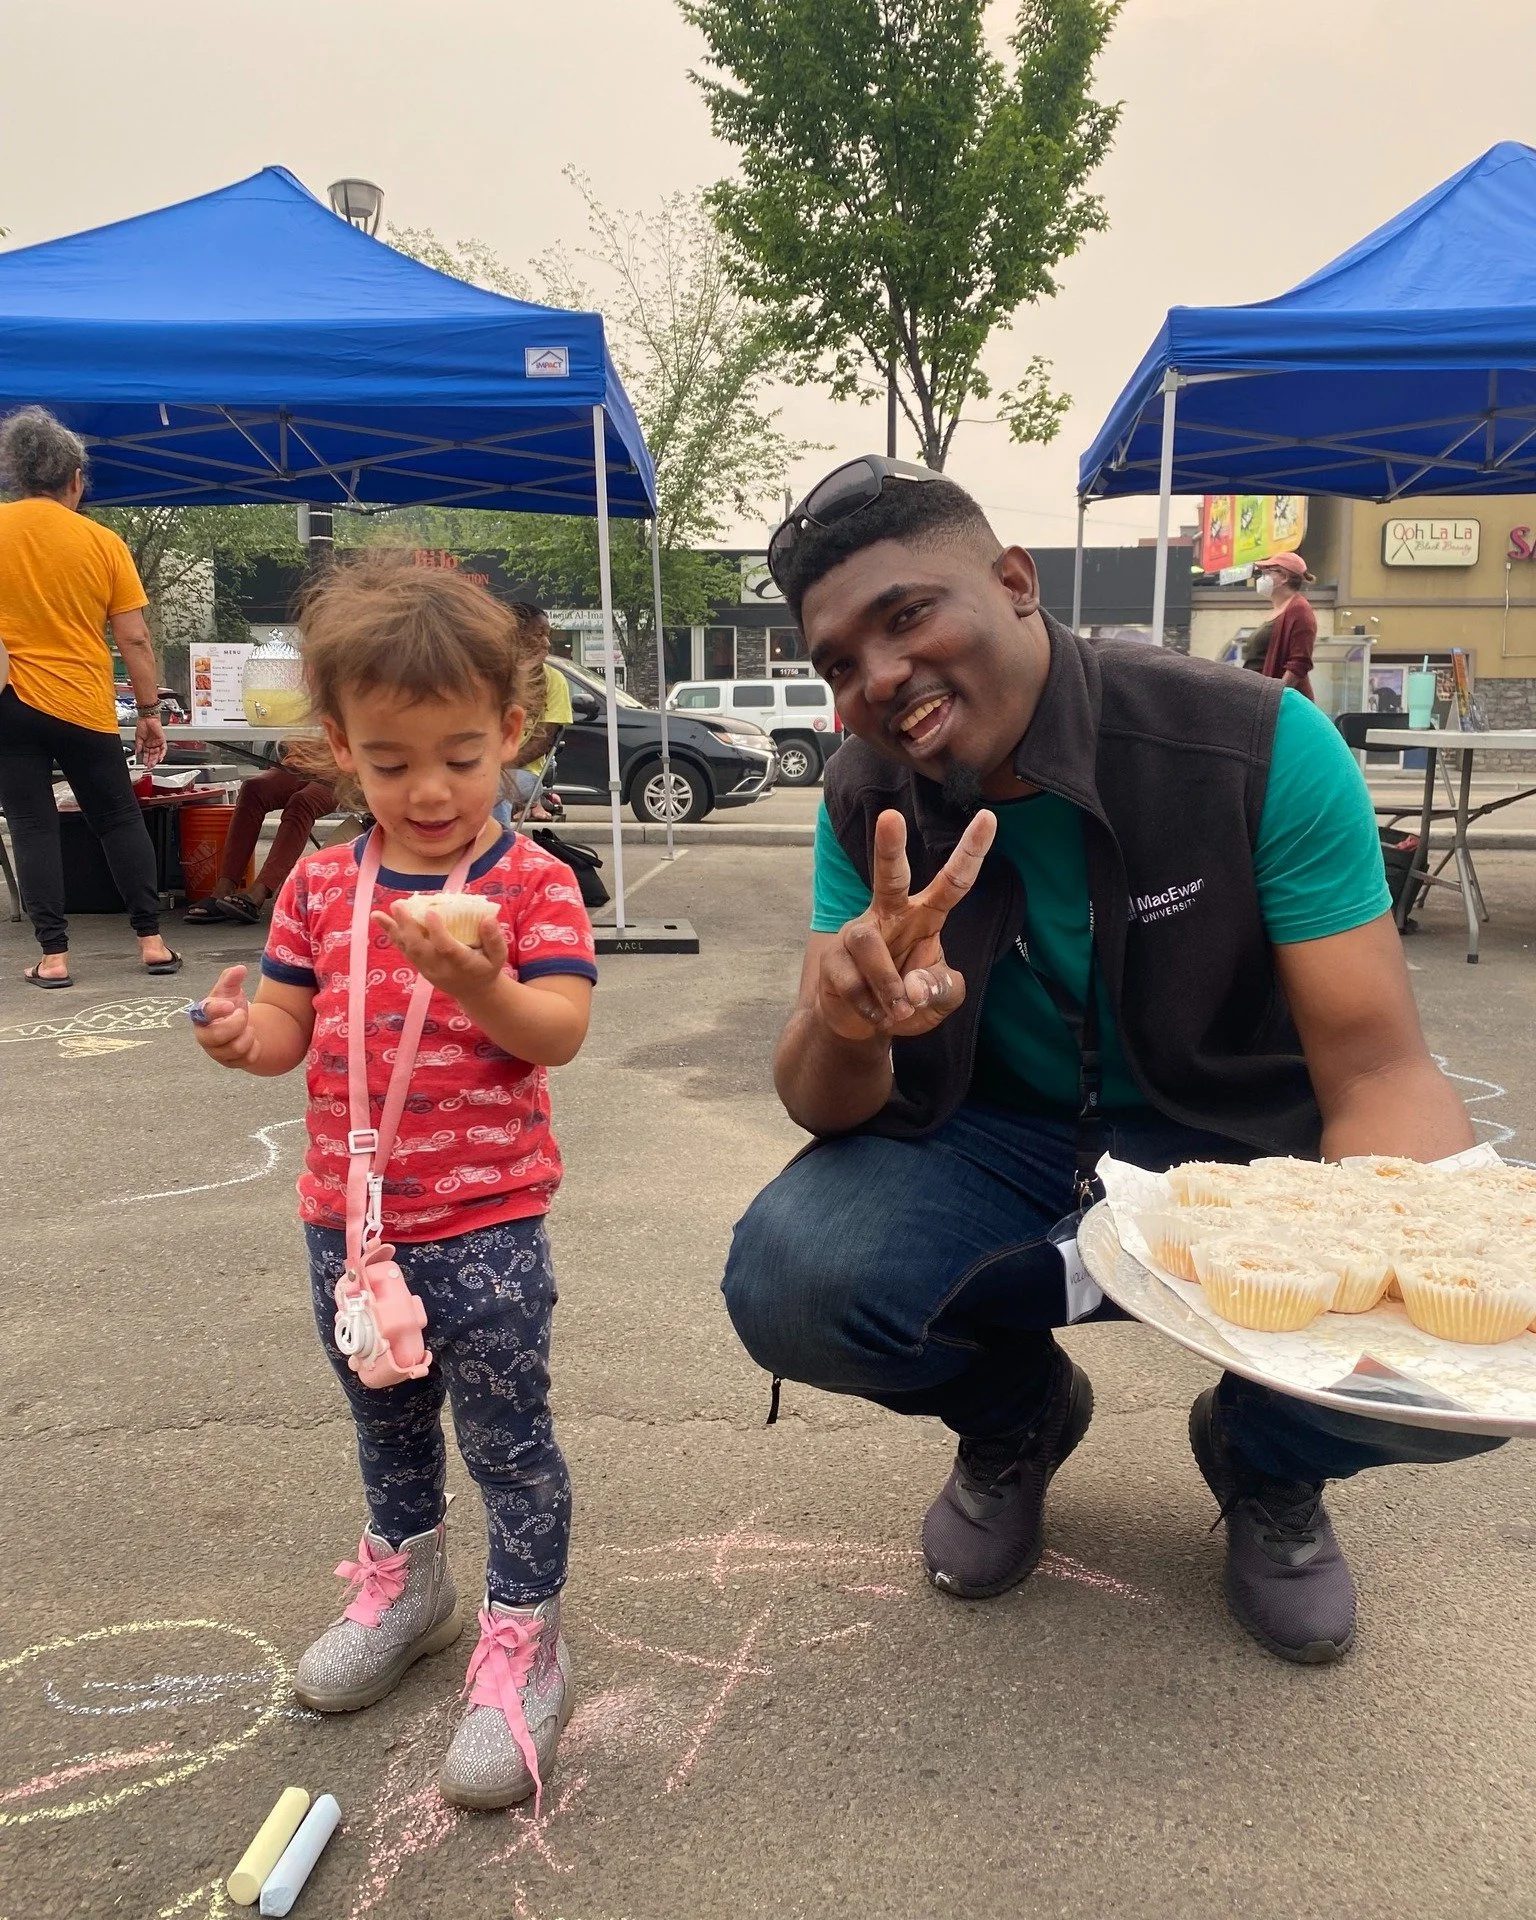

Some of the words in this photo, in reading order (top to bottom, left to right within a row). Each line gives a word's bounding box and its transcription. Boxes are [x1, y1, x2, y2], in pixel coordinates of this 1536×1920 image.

[1393, 523, 1424, 540] Ooh
[1431, 523, 1448, 540] La
[1454, 523, 1472, 540] La
[1507, 525, 1536, 560] S
[1136, 878, 1205, 912] MacEwan
[615, 942, 643, 950] AACL
